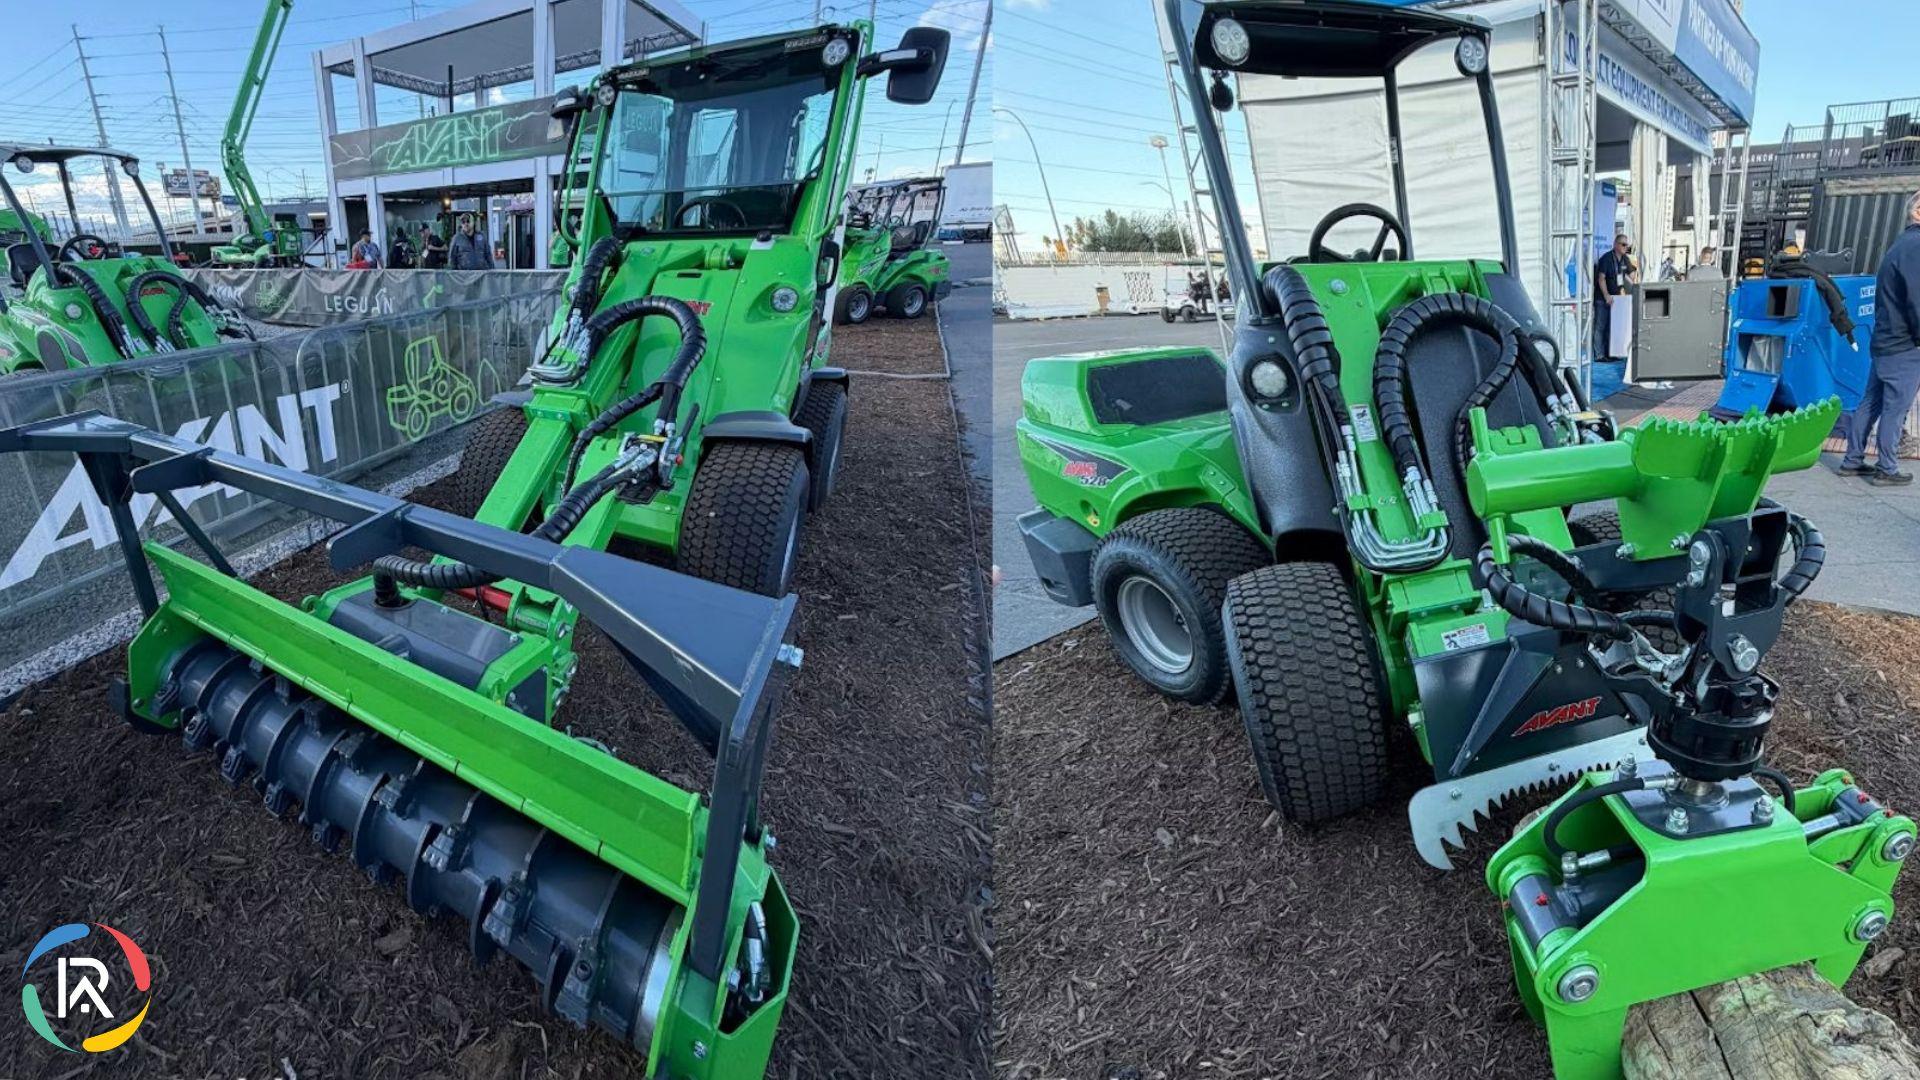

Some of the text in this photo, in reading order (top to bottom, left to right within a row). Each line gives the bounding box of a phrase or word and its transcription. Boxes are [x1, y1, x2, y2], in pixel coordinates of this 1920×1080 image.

[387, 110, 503, 171] AVANT
[1081, 475, 1109, 488] 528
[1511, 696, 1602, 737] AVANT
